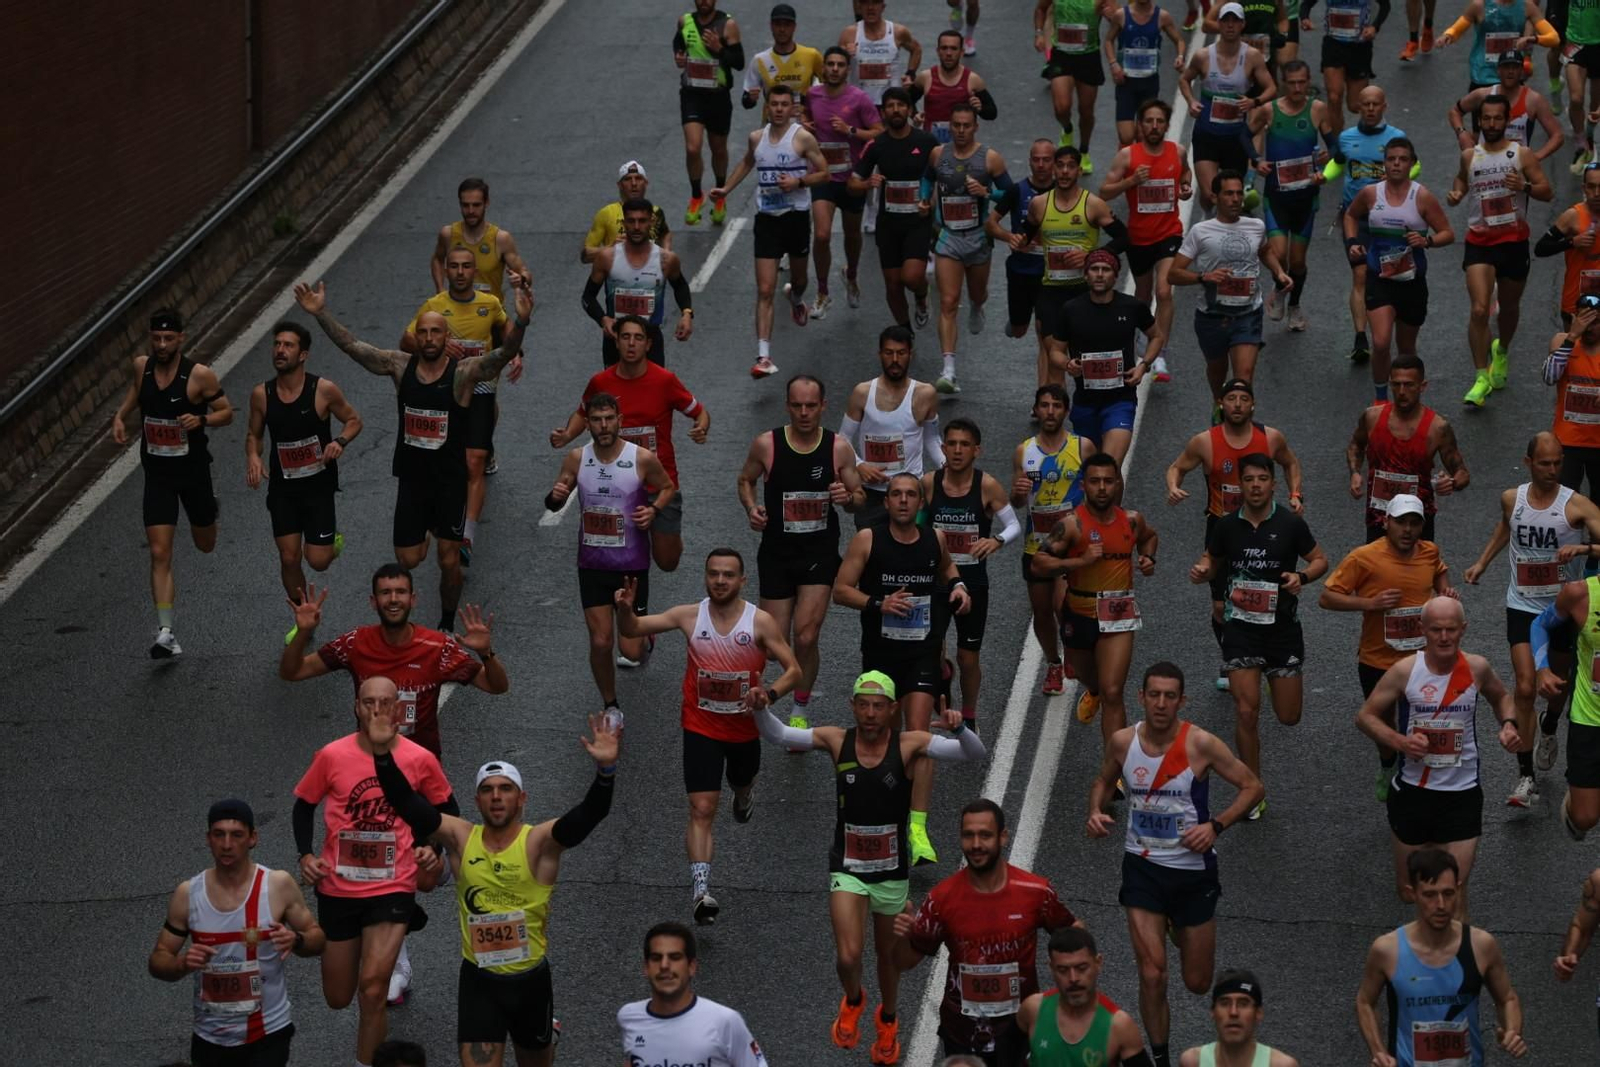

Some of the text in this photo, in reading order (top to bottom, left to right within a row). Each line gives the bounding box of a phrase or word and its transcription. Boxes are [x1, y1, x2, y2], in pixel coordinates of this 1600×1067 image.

[410, 416, 437, 432] 1098
[150, 424, 176, 440] 1413
[286, 447, 312, 462] 1099
[934, 511, 976, 522] amazfit
[1517, 524, 1559, 549] ENA
[1243, 548, 1267, 559] TIRA
[881, 573, 896, 582] DH
[710, 681, 734, 696] 327
[1138, 814, 1171, 831] 2147
[477, 925, 514, 944] 3542
[212, 977, 241, 992] 978
[1423, 1034, 1462, 1053] 1308
